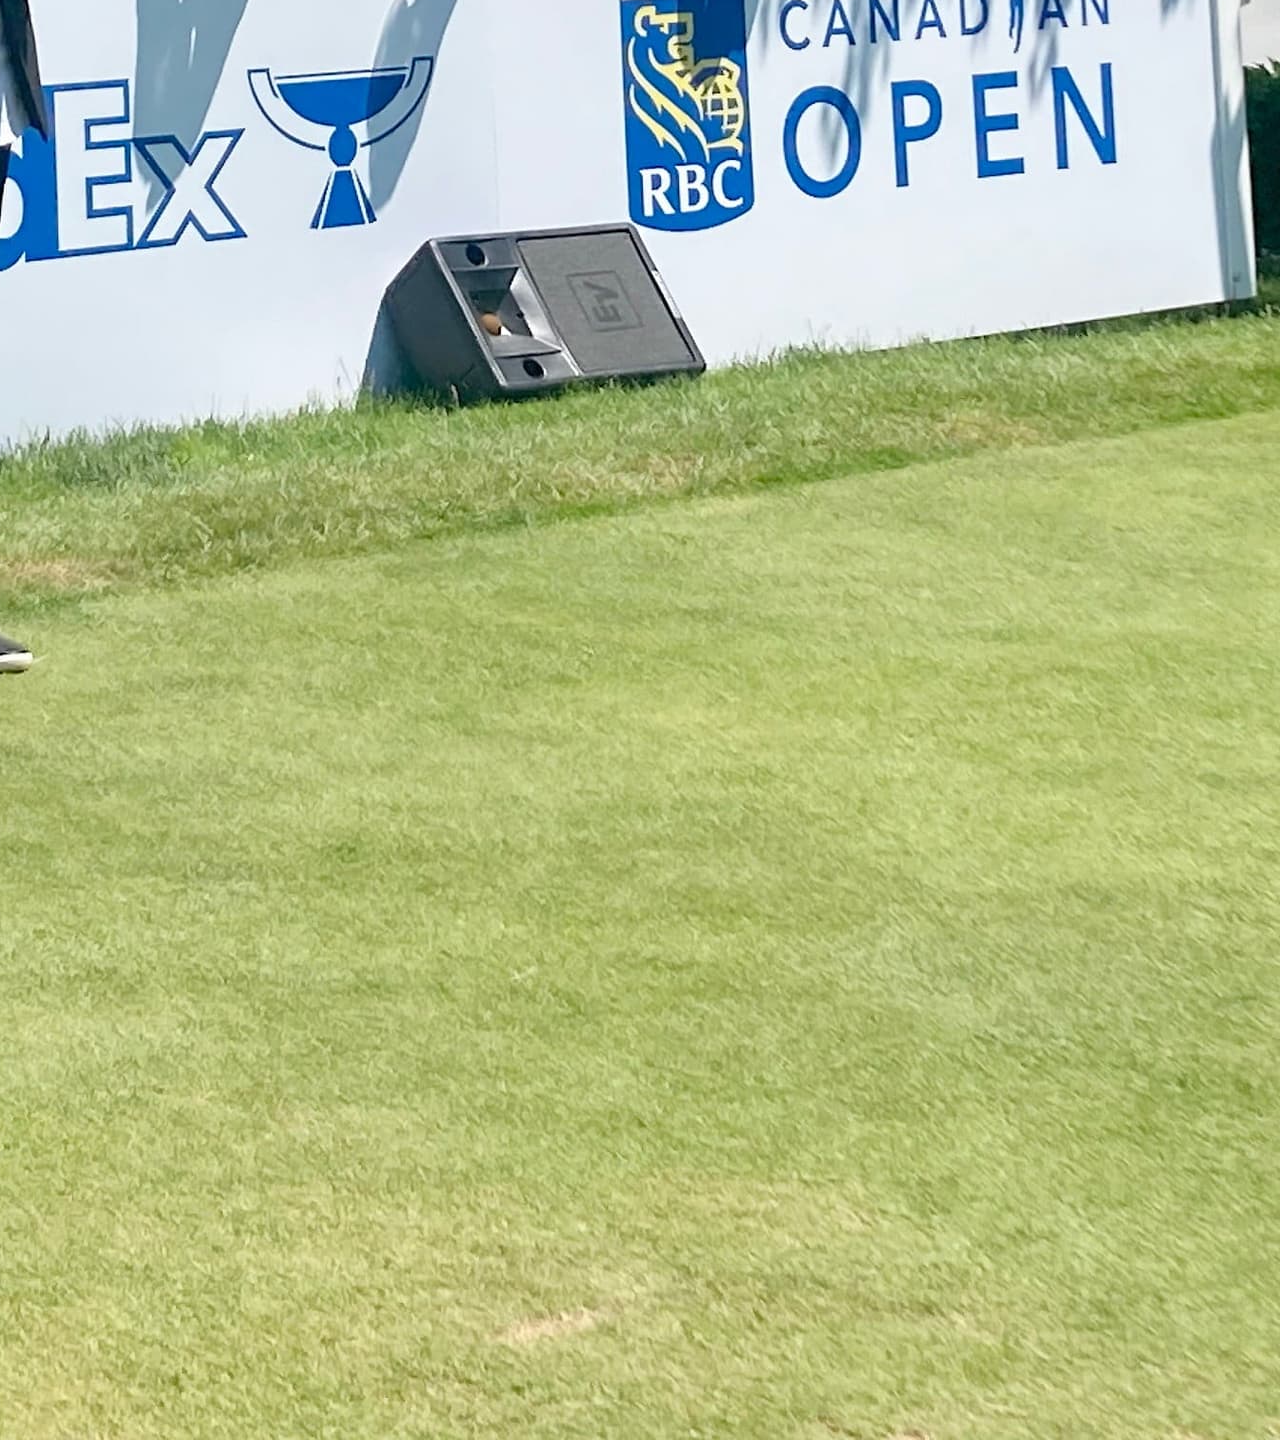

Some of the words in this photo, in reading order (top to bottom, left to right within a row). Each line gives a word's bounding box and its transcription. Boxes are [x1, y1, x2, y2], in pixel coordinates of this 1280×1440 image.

[782, 62, 1118, 199] OPEN
[639, 159, 744, 217] RBC
[581, 280, 623, 323] EV
